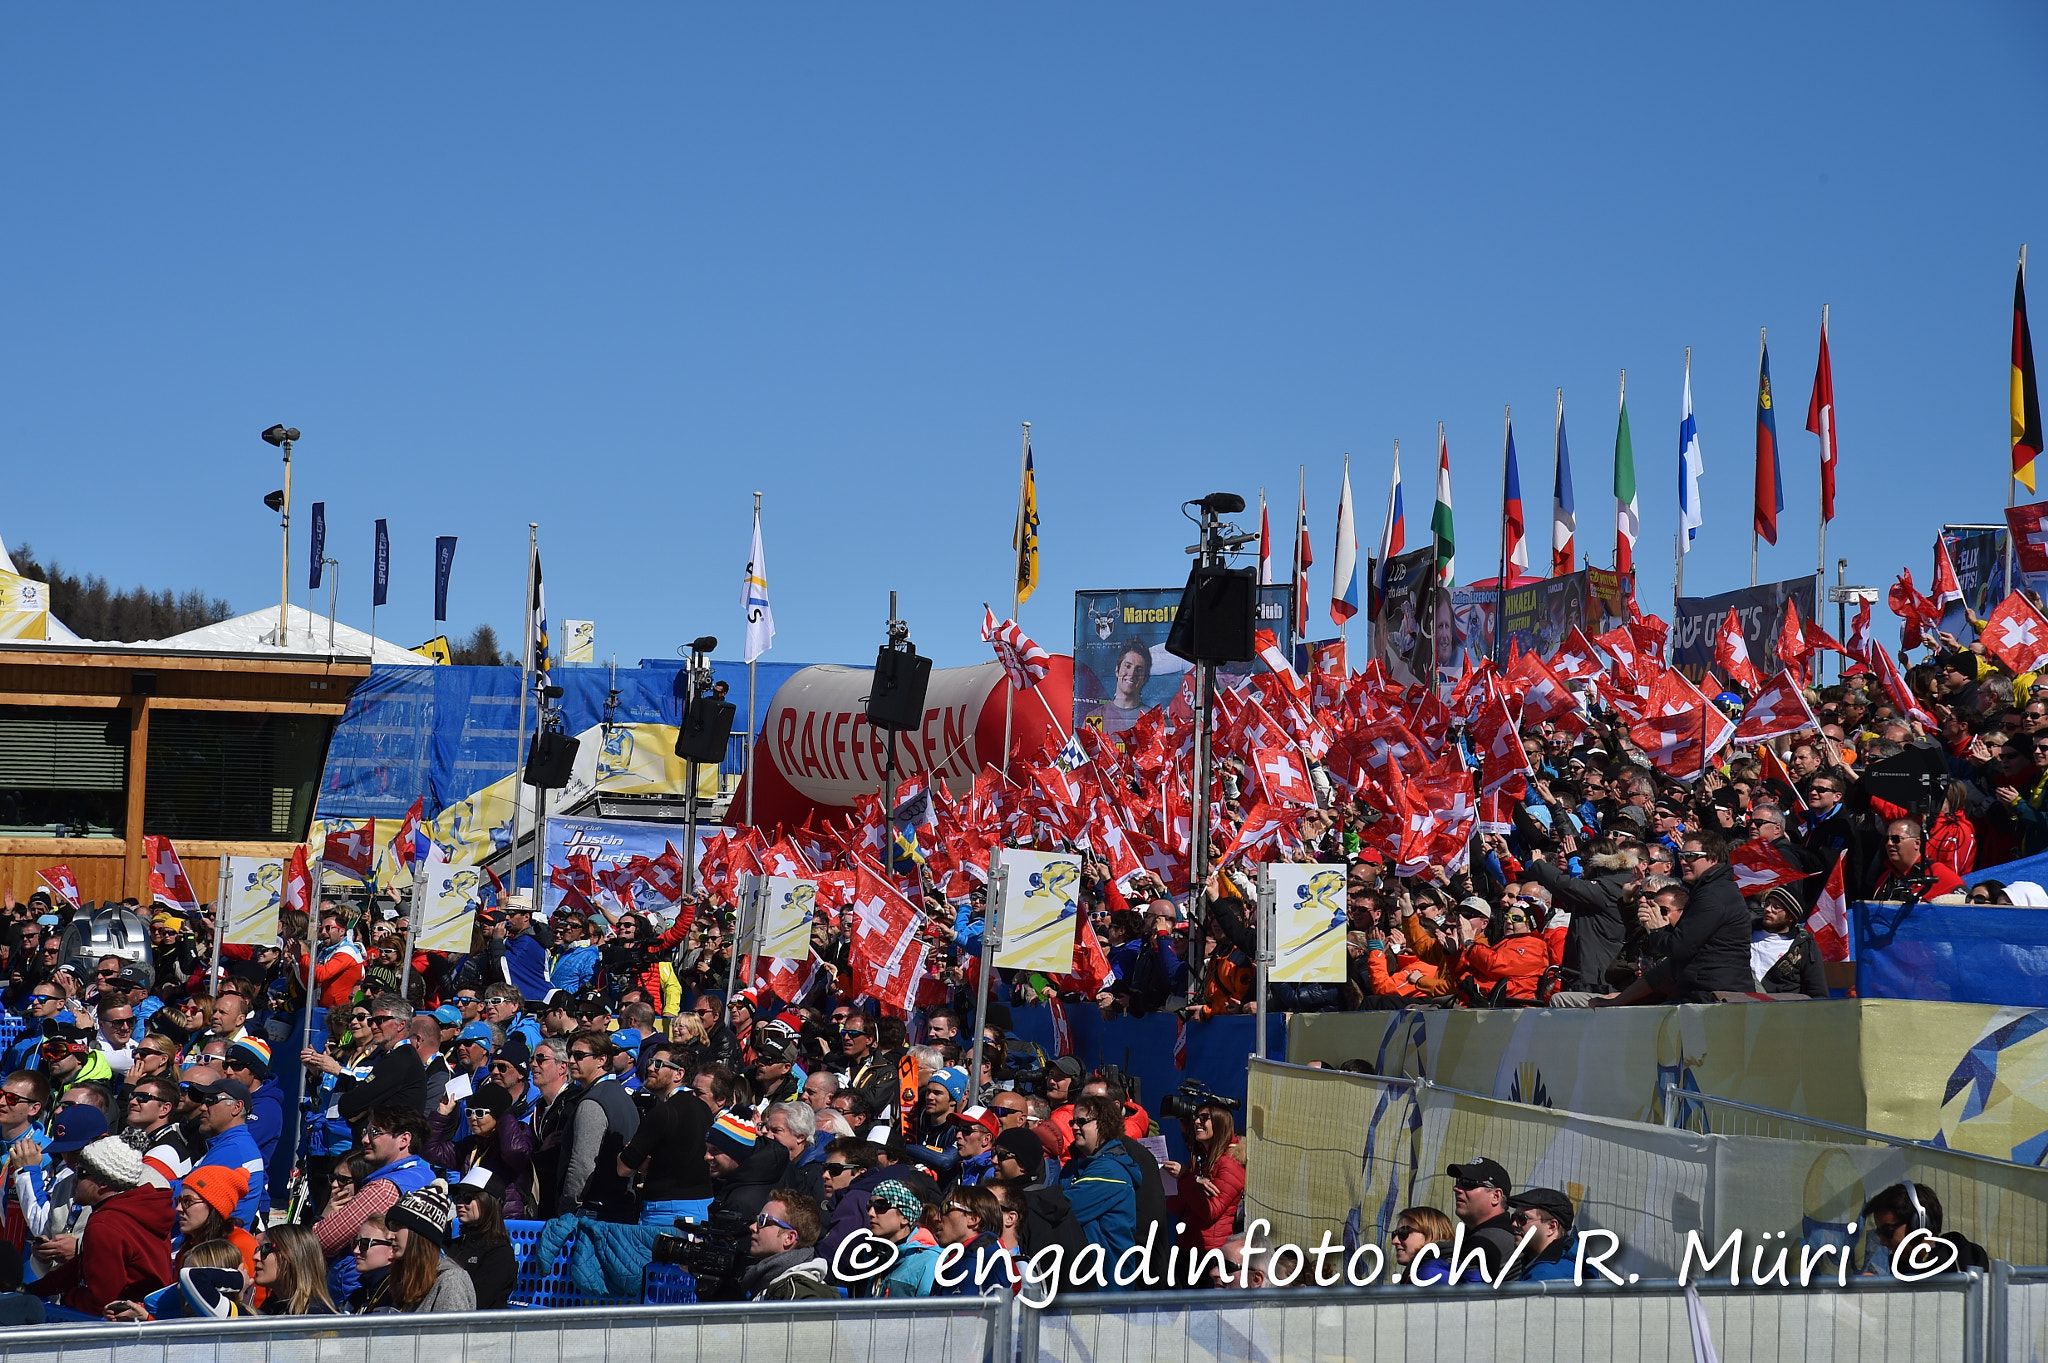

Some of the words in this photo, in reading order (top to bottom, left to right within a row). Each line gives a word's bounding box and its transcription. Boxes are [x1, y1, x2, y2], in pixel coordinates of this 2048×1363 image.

[1958, 547, 1979, 571] ELIX
[1505, 590, 1537, 617] MIKAELA
[1123, 606, 1168, 624] Marcel
[563, 830, 624, 846] Justin
[566, 844, 640, 863] Muris
